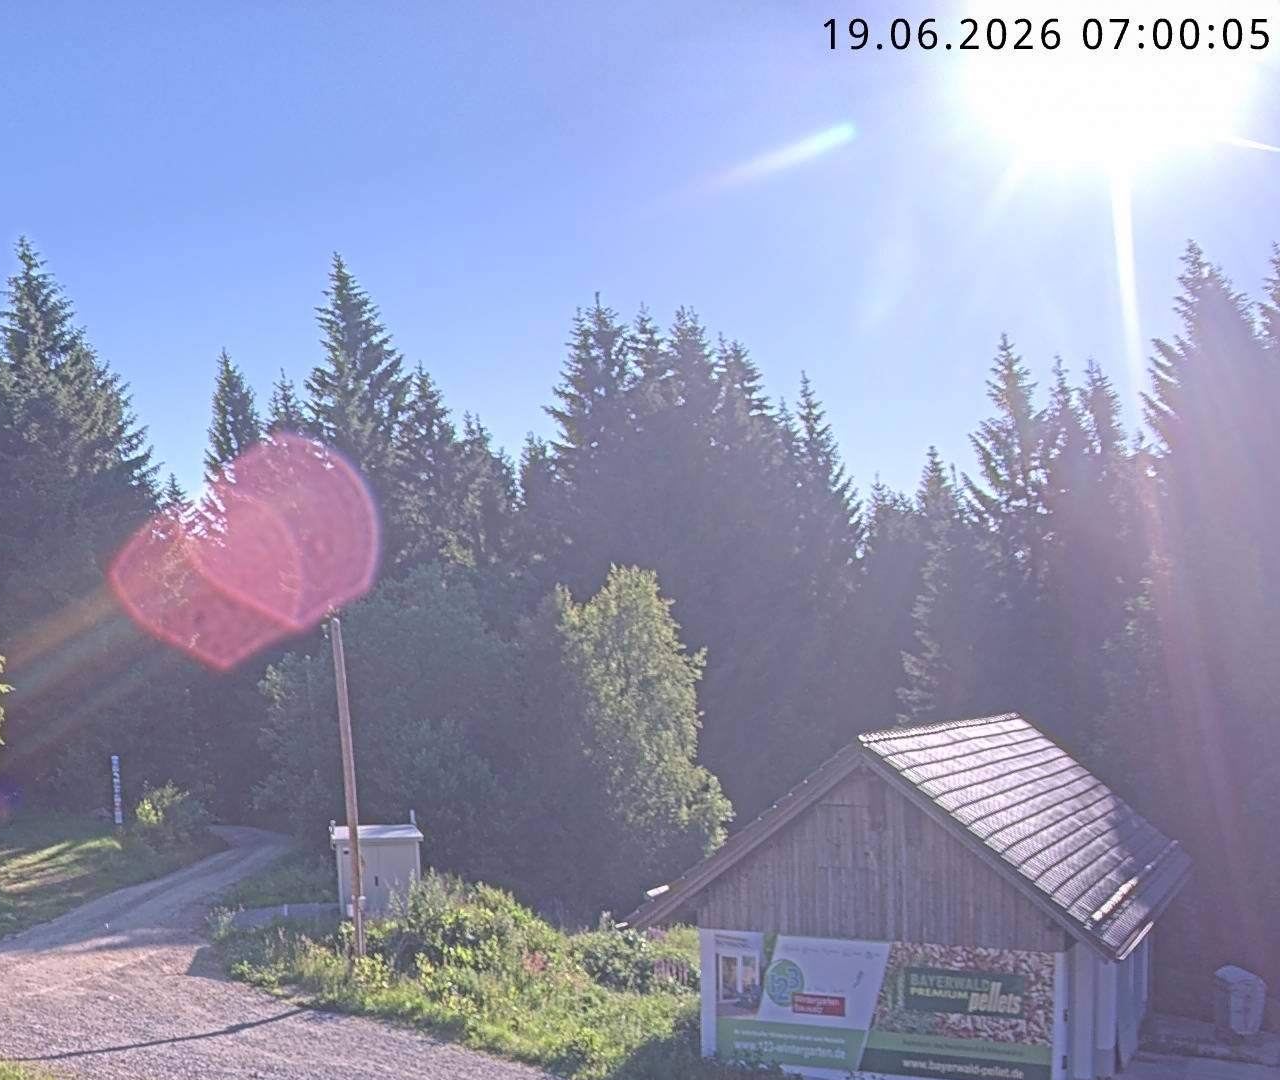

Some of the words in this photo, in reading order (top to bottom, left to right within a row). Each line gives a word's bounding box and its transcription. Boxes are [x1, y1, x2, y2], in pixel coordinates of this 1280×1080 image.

[909, 973, 990, 991] BAYERWALD
[909, 986, 969, 999] PREMIUM
[968, 982, 1022, 1014] pellets
[902, 1059, 1025, 1080] www.bayerwald-pellet.de
